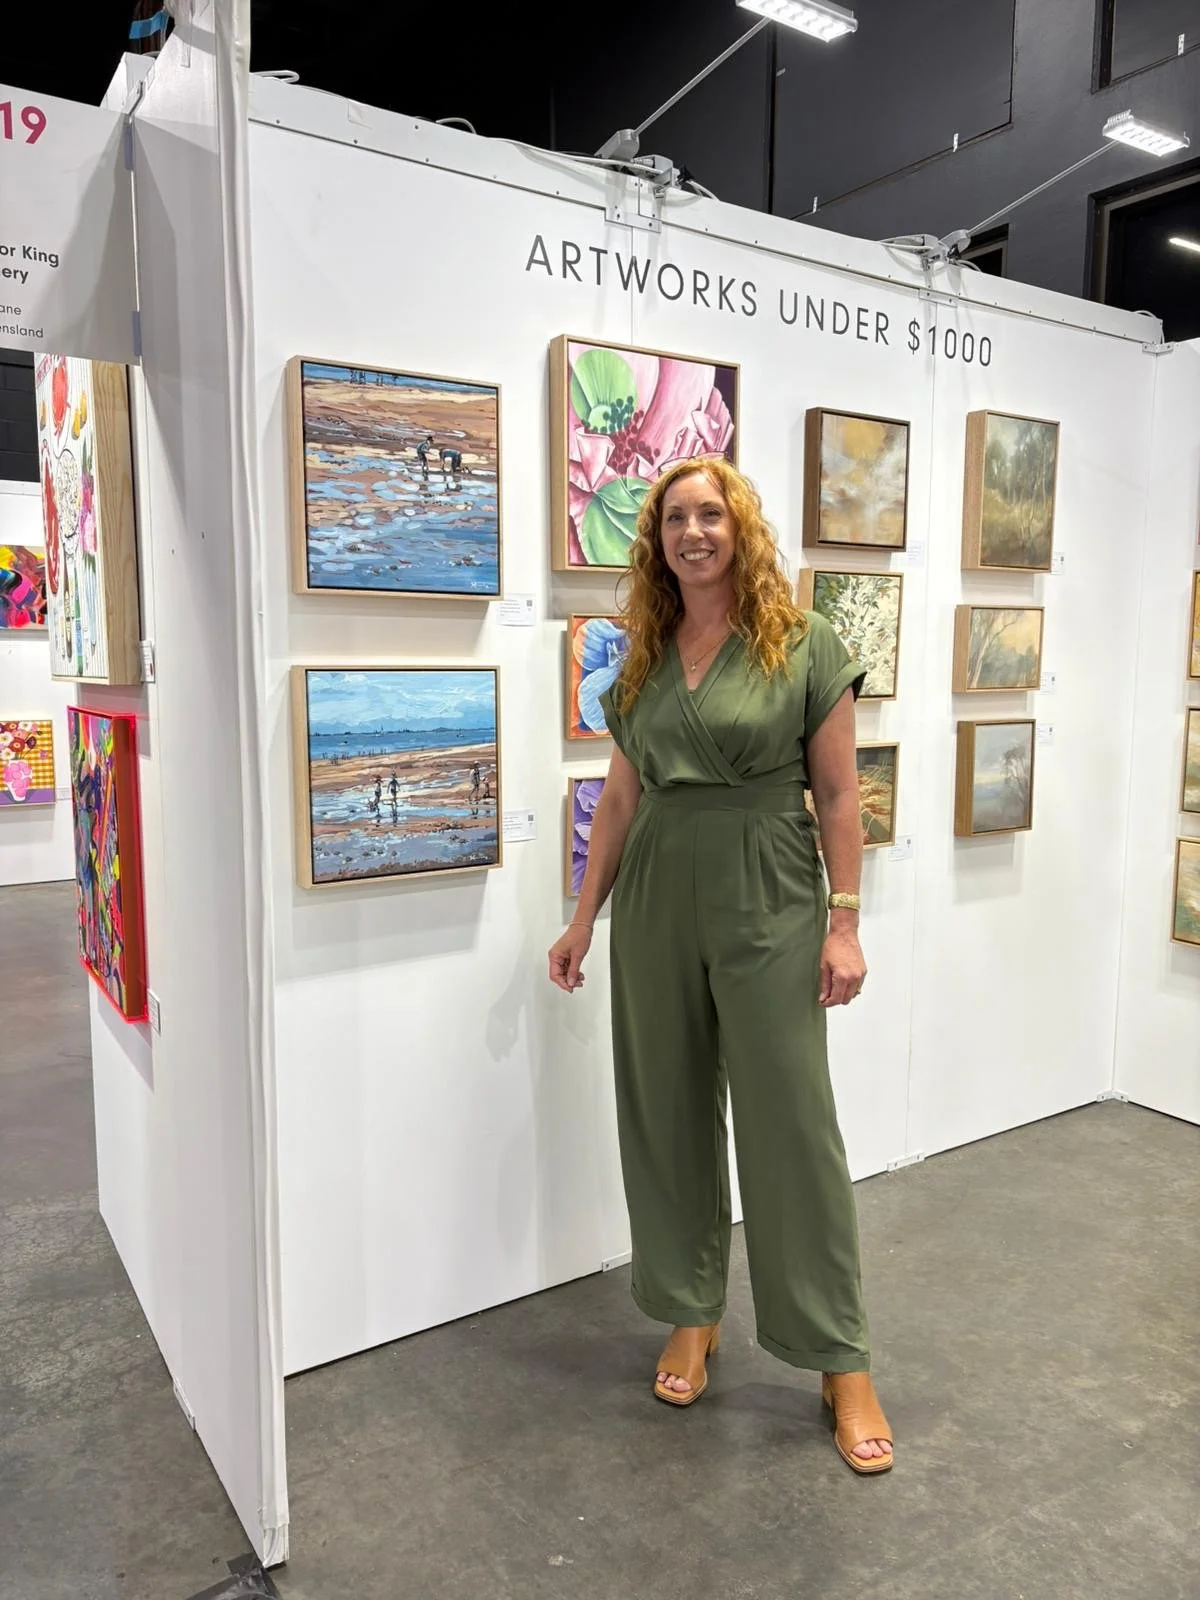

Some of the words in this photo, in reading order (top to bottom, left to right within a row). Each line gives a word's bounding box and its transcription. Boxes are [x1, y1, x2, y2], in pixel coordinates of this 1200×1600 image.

[0, 101, 47, 145] 19
[22, 245, 59, 268] King
[525, 234, 758, 318] ARTWORKS
[779, 288, 890, 346] UNDER
[907, 317, 992, 367] $1000
[0, 323, 44, 339] nsland
